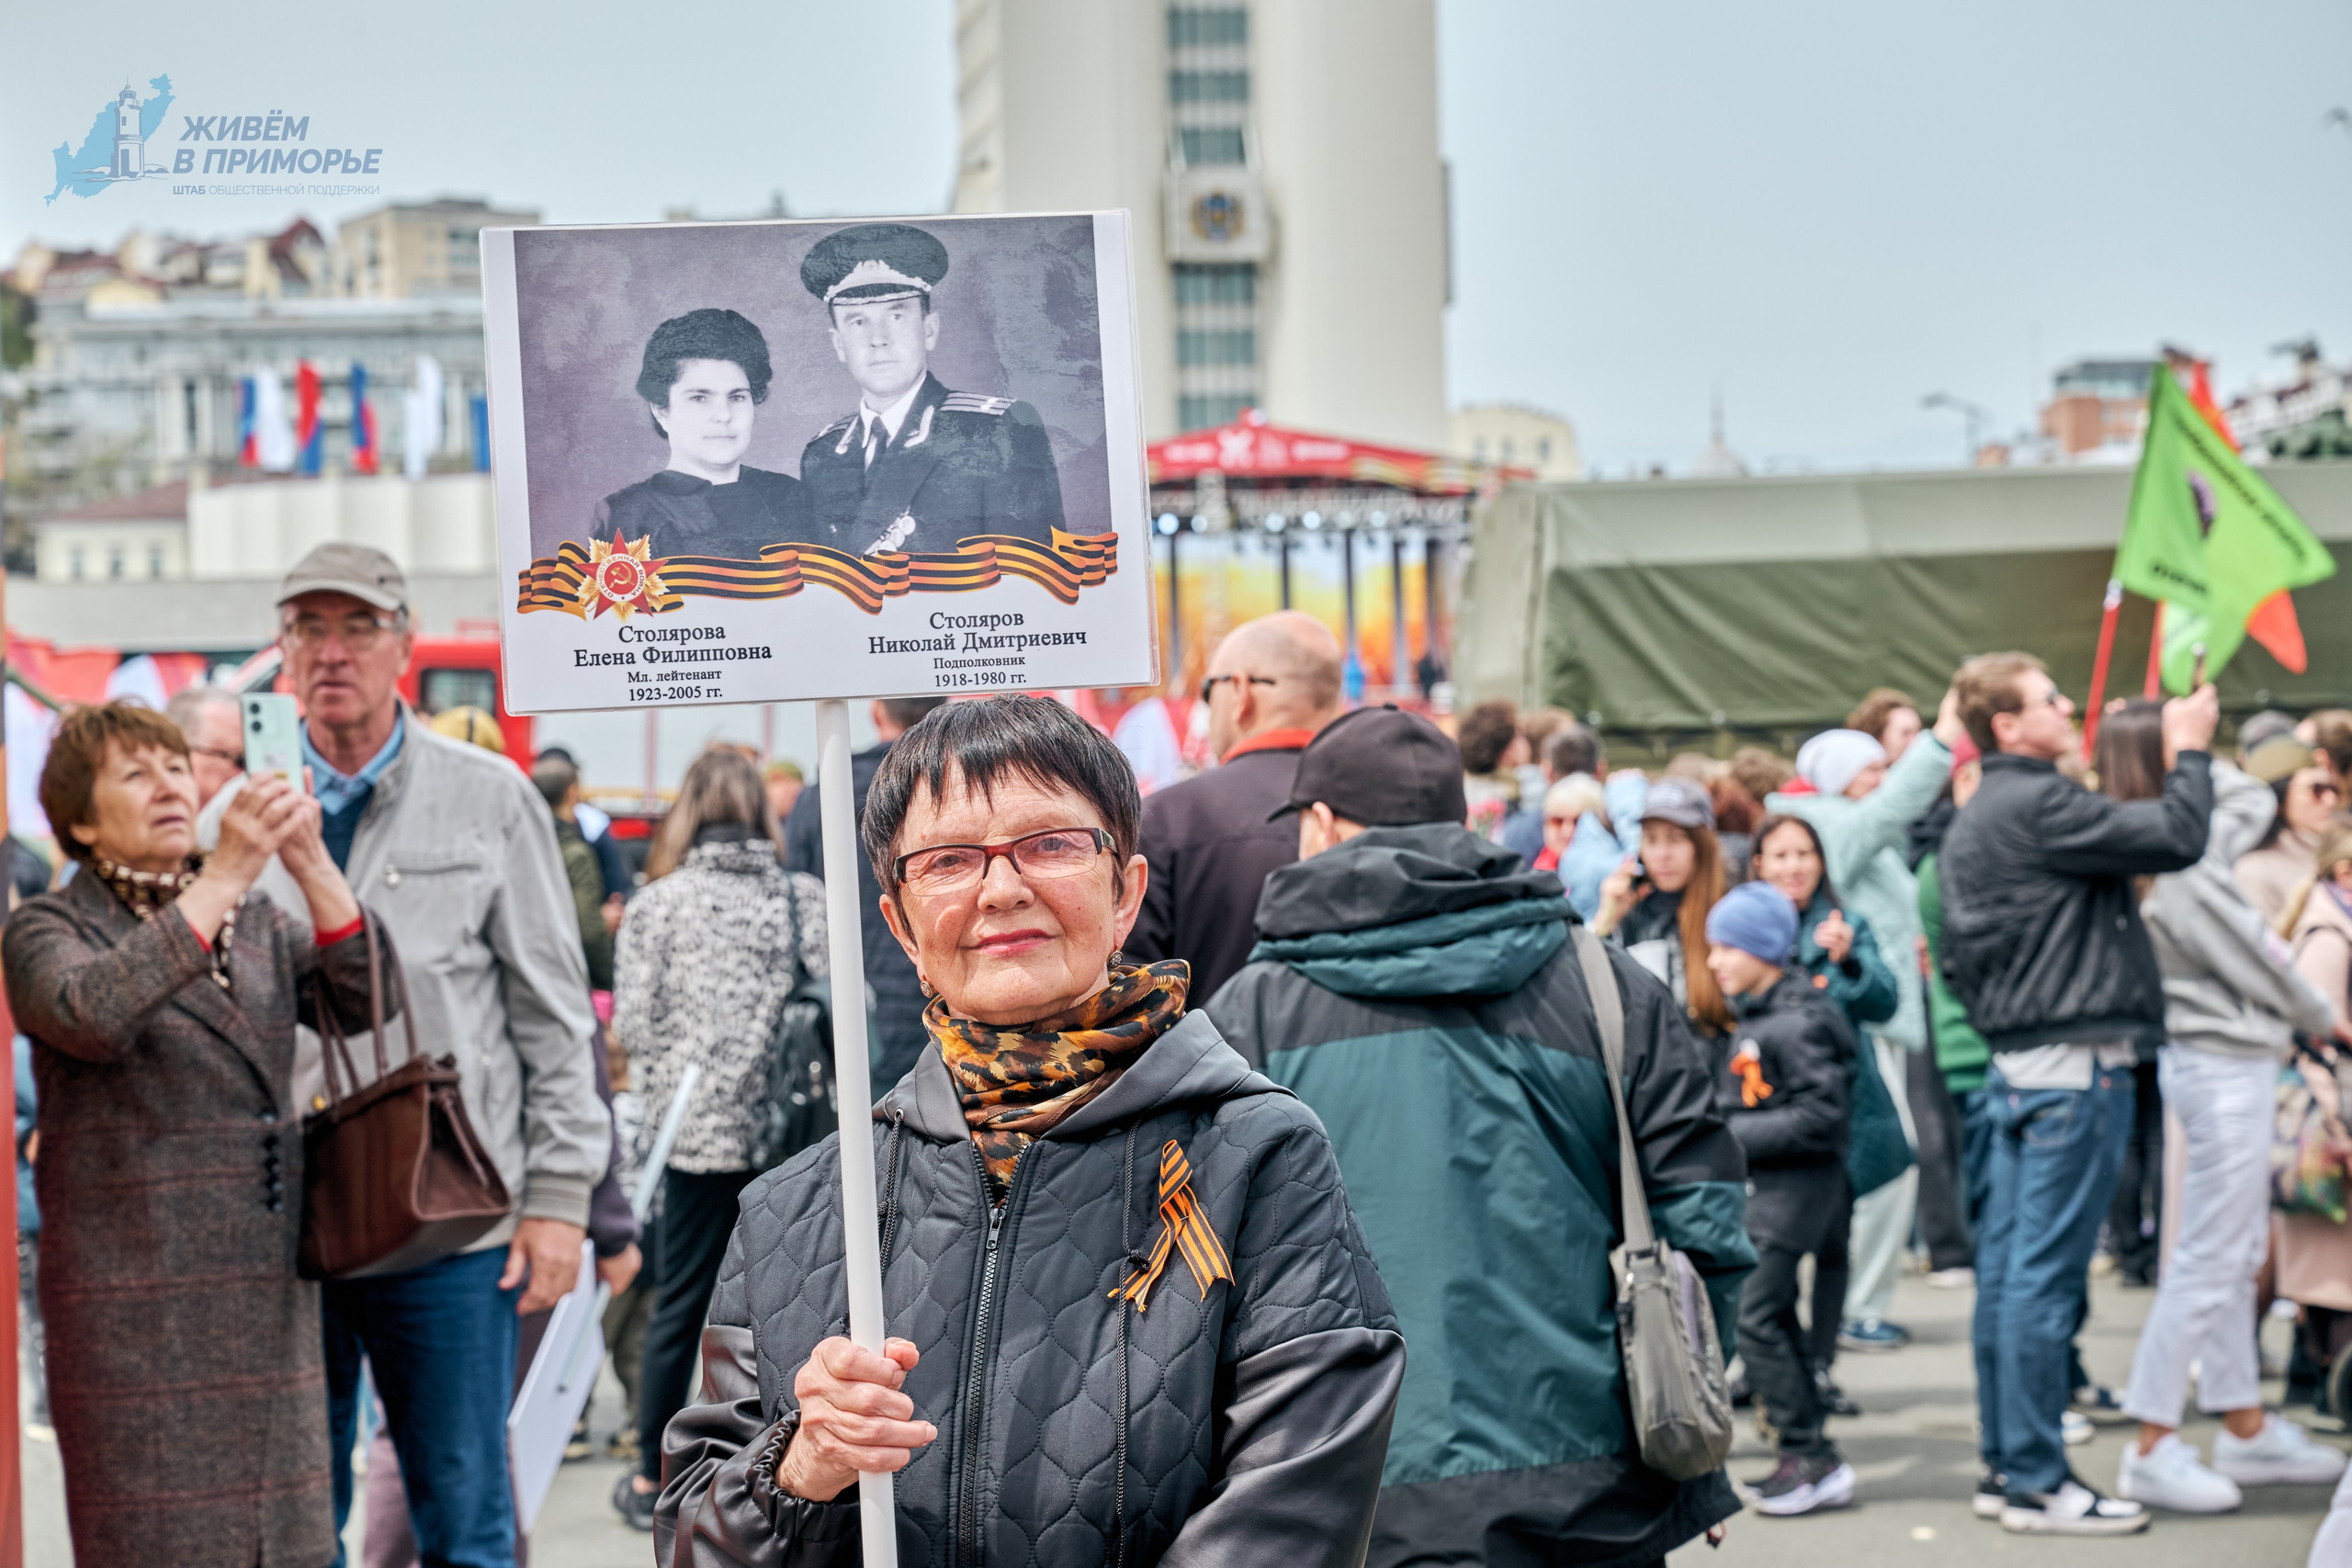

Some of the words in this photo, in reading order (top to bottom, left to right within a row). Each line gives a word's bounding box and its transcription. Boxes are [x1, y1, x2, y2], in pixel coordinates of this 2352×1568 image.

[598, 555, 640, 598] ОТЕЧЕСТВЕННАЯ
[630, 569, 645, 596] ВОЙНА
[930, 612, 1024, 631] Столяров
[618, 626, 726, 645] Столярова
[868, 633, 956, 654] Николай
[962, 630, 1087, 654] Дмитриевич
[574, 649, 636, 667] Елена
[642, 645, 773, 664] Филипповна
[933, 656, 1026, 670] Подполковник
[628, 671, 652, 683] Мл.
[656, 670, 722, 682] лейтенант
[934, 671, 1006, 687] 1918-1980
[1011, 672, 1027, 683] гг.
[629, 686, 702, 702] 1923-2005
[706, 688, 723, 698] гг.
